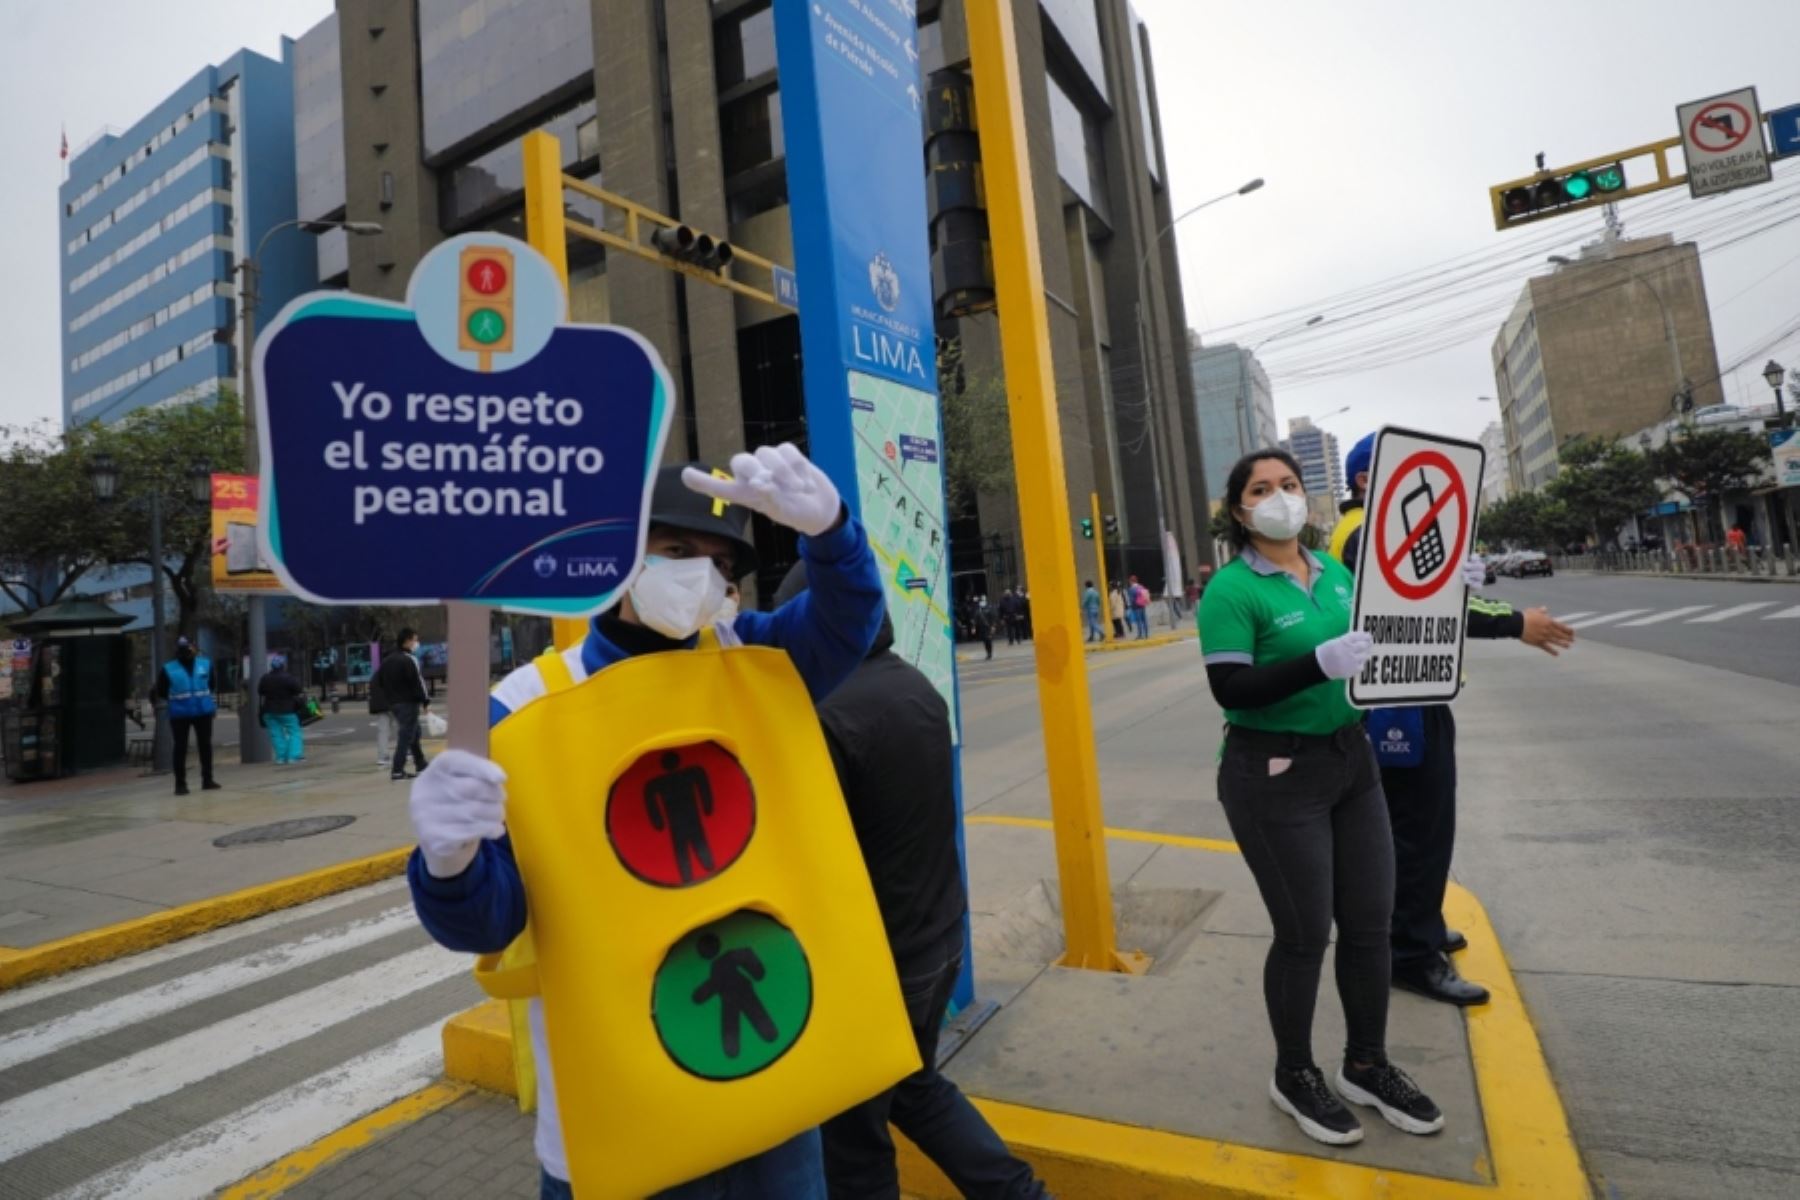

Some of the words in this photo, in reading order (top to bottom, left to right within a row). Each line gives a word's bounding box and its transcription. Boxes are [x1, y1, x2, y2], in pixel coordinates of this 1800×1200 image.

[852, 325, 926, 379] LIMA
[331, 381, 392, 421] Yo
[406, 391, 583, 433] respeto
[323, 430, 368, 470] el
[381, 432, 604, 474] semáforo
[215, 480, 248, 499] 25
[354, 478, 567, 525] peatonal
[566, 562, 618, 577] LIMA
[1423, 616, 1435, 645] EL
[1436, 616, 1458, 645] USO
[1380, 654, 1454, 685] CELULARES
